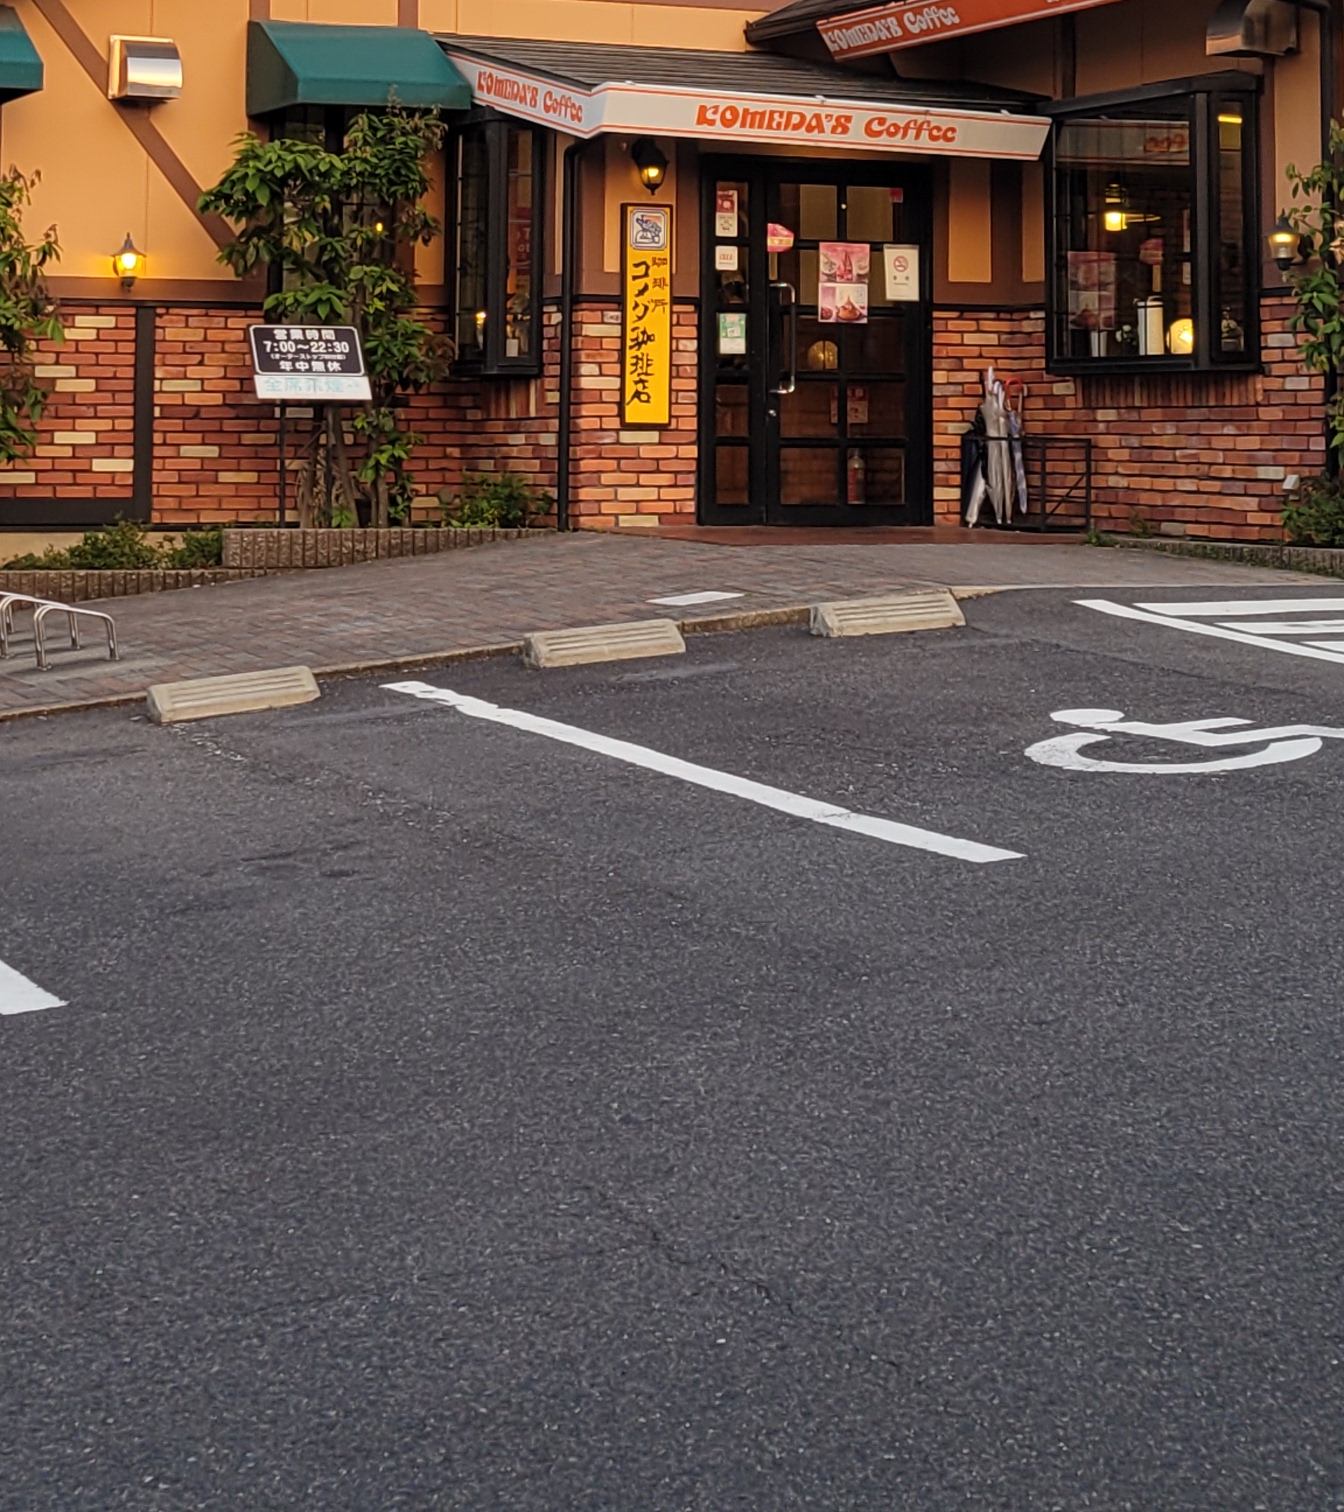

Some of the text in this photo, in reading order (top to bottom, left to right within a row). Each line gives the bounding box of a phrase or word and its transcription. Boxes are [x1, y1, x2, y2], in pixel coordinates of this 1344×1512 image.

[823, 5, 960, 54] KOMEDA'S Coffee
[477, 70, 583, 124] KOMEDA'S Coffee
[695, 104, 958, 143] KOMEDA'S Coffee
[626, 260, 655, 405] コメダ珈琲店
[279, 361, 342, 372] 年中無休
